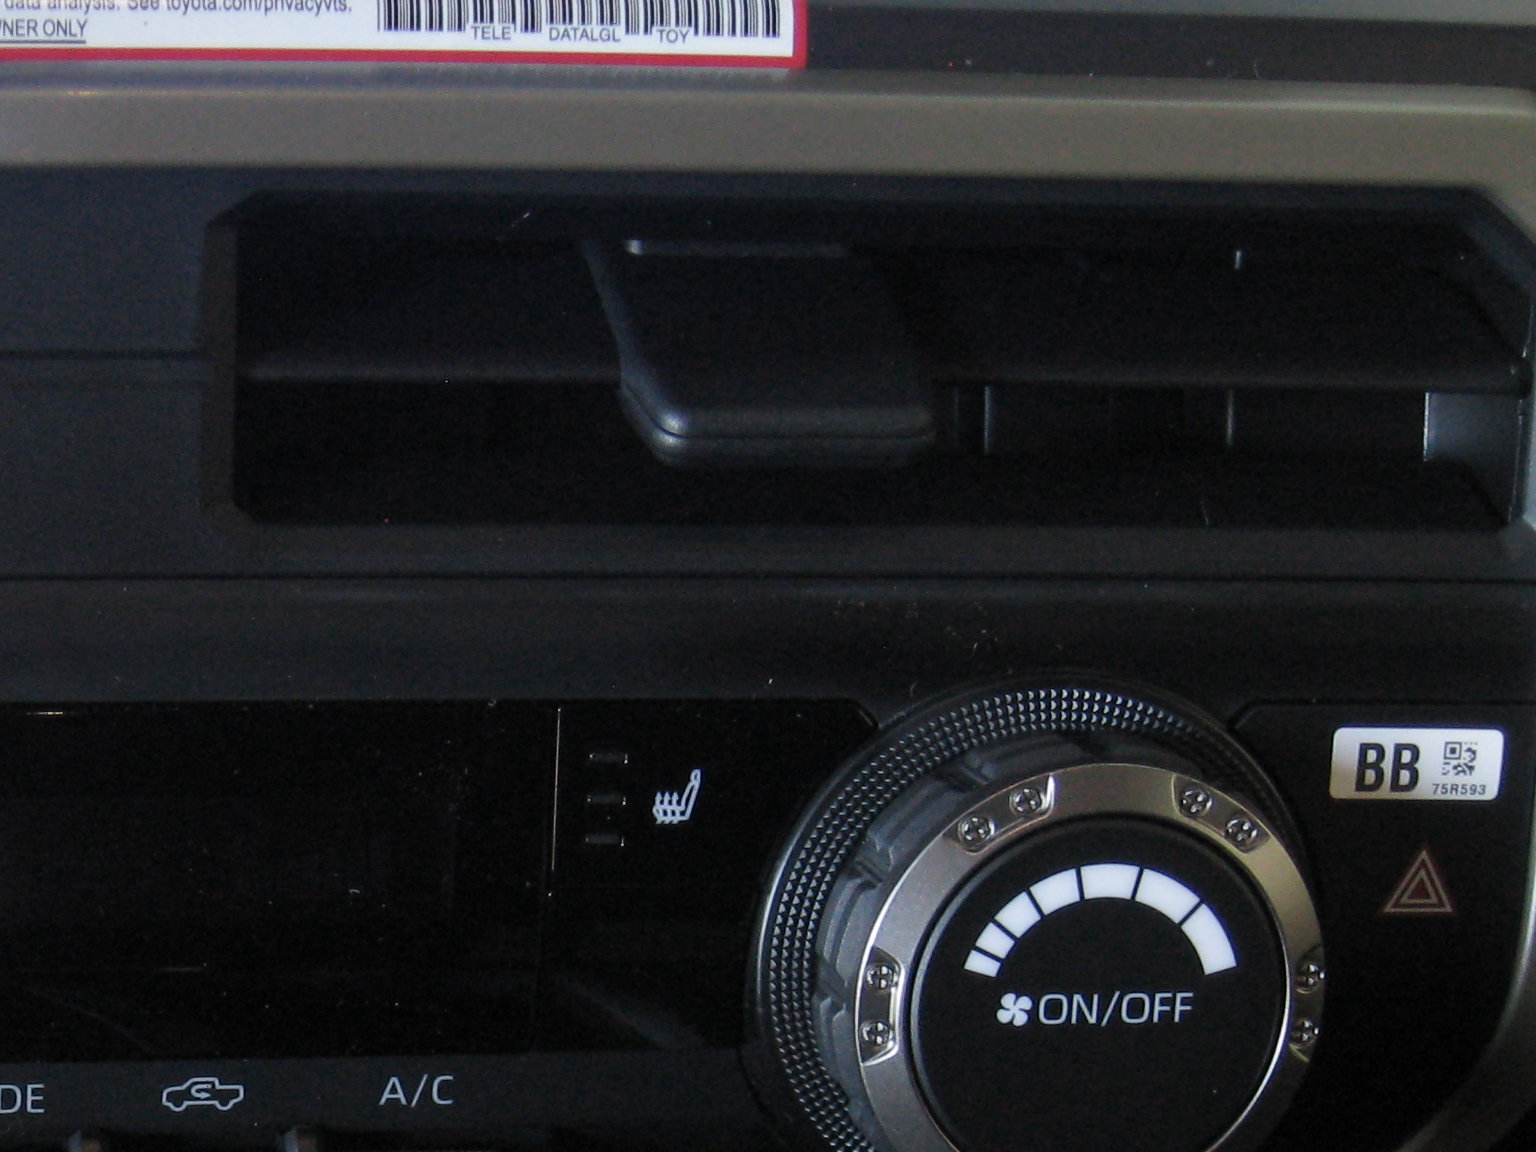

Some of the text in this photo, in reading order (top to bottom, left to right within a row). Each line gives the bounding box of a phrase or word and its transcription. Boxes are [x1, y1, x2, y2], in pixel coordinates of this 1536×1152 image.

[43, 18, 88, 38] ONLY
[471, 26, 690, 43] TELE DATALGL TOY
[1355, 742, 1420, 793] BB
[1431, 783, 1487, 796] 75R593
[1038, 991, 1194, 1027] ON/OFF
[378, 1074, 454, 1107] A/C
